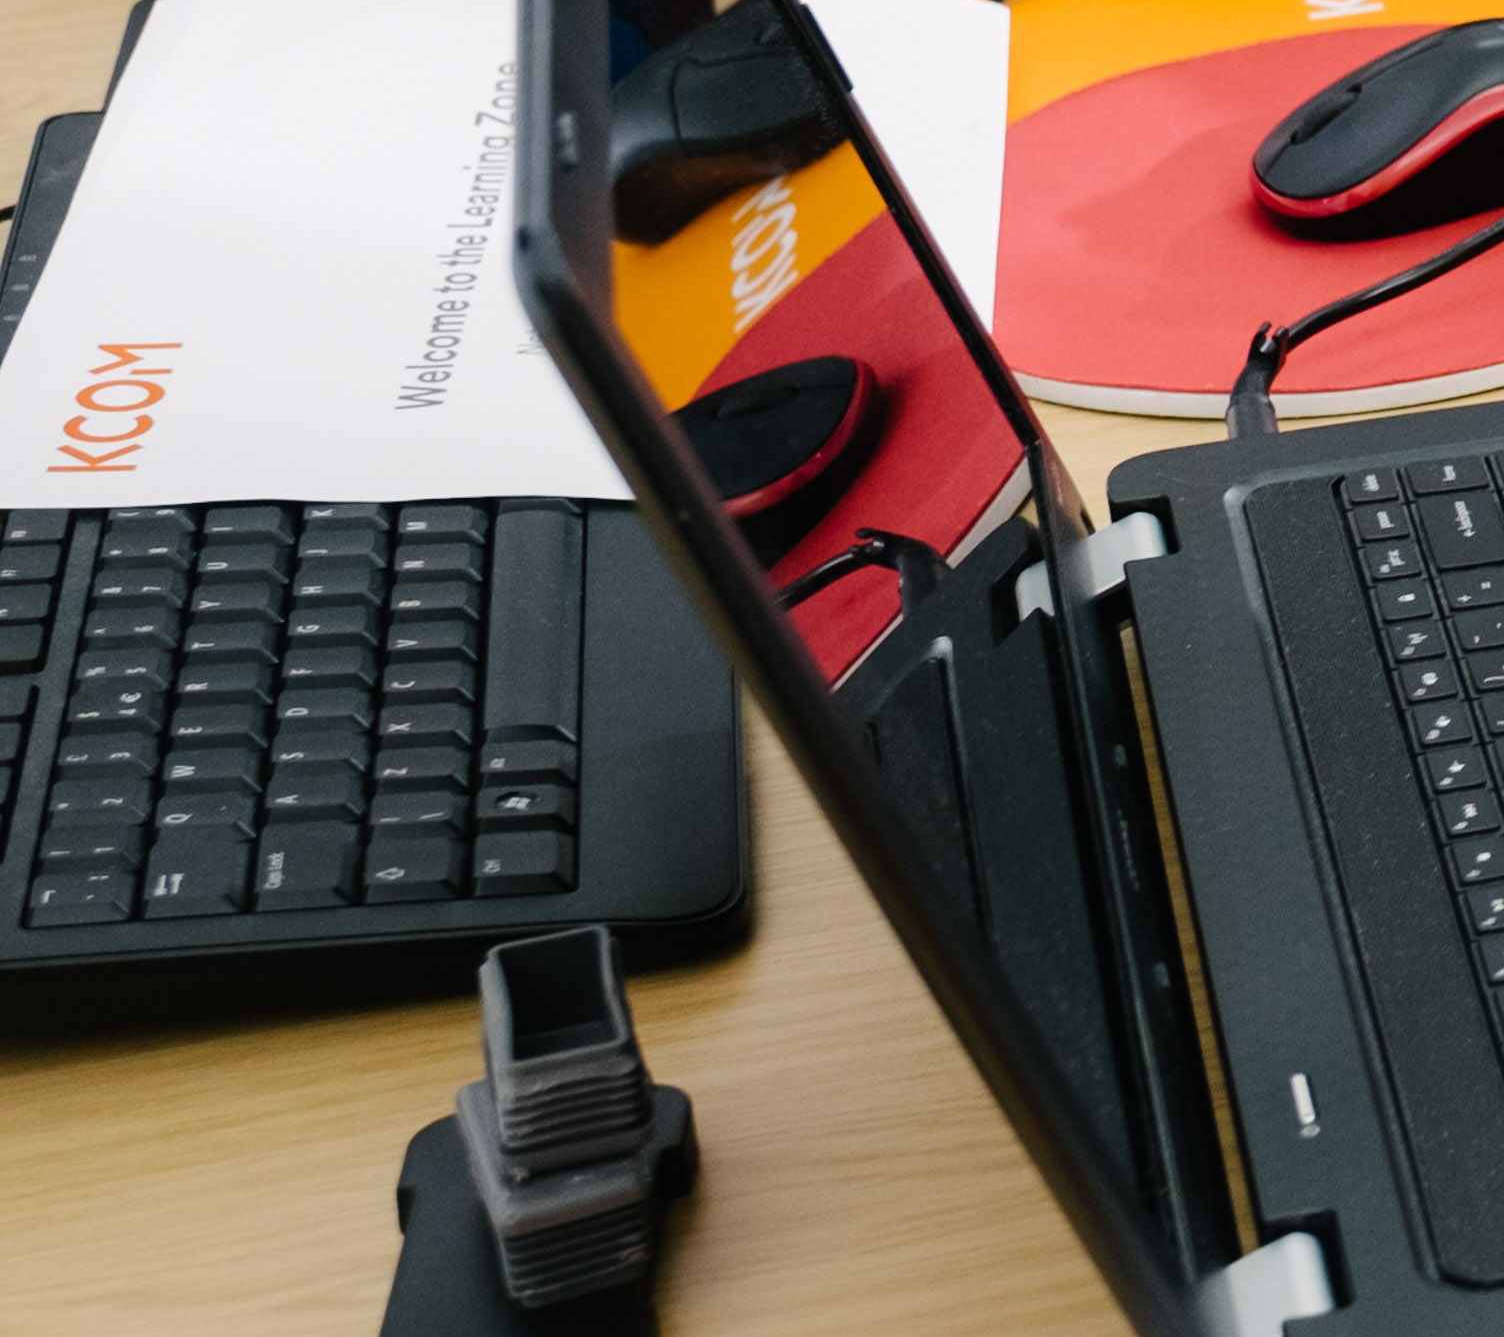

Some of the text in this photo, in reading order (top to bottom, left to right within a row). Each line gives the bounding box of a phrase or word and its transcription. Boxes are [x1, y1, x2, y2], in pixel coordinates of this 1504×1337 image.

[394, 60, 518, 411] Welcome to the Learning Zone
[46, 341, 183, 474] KCOM
